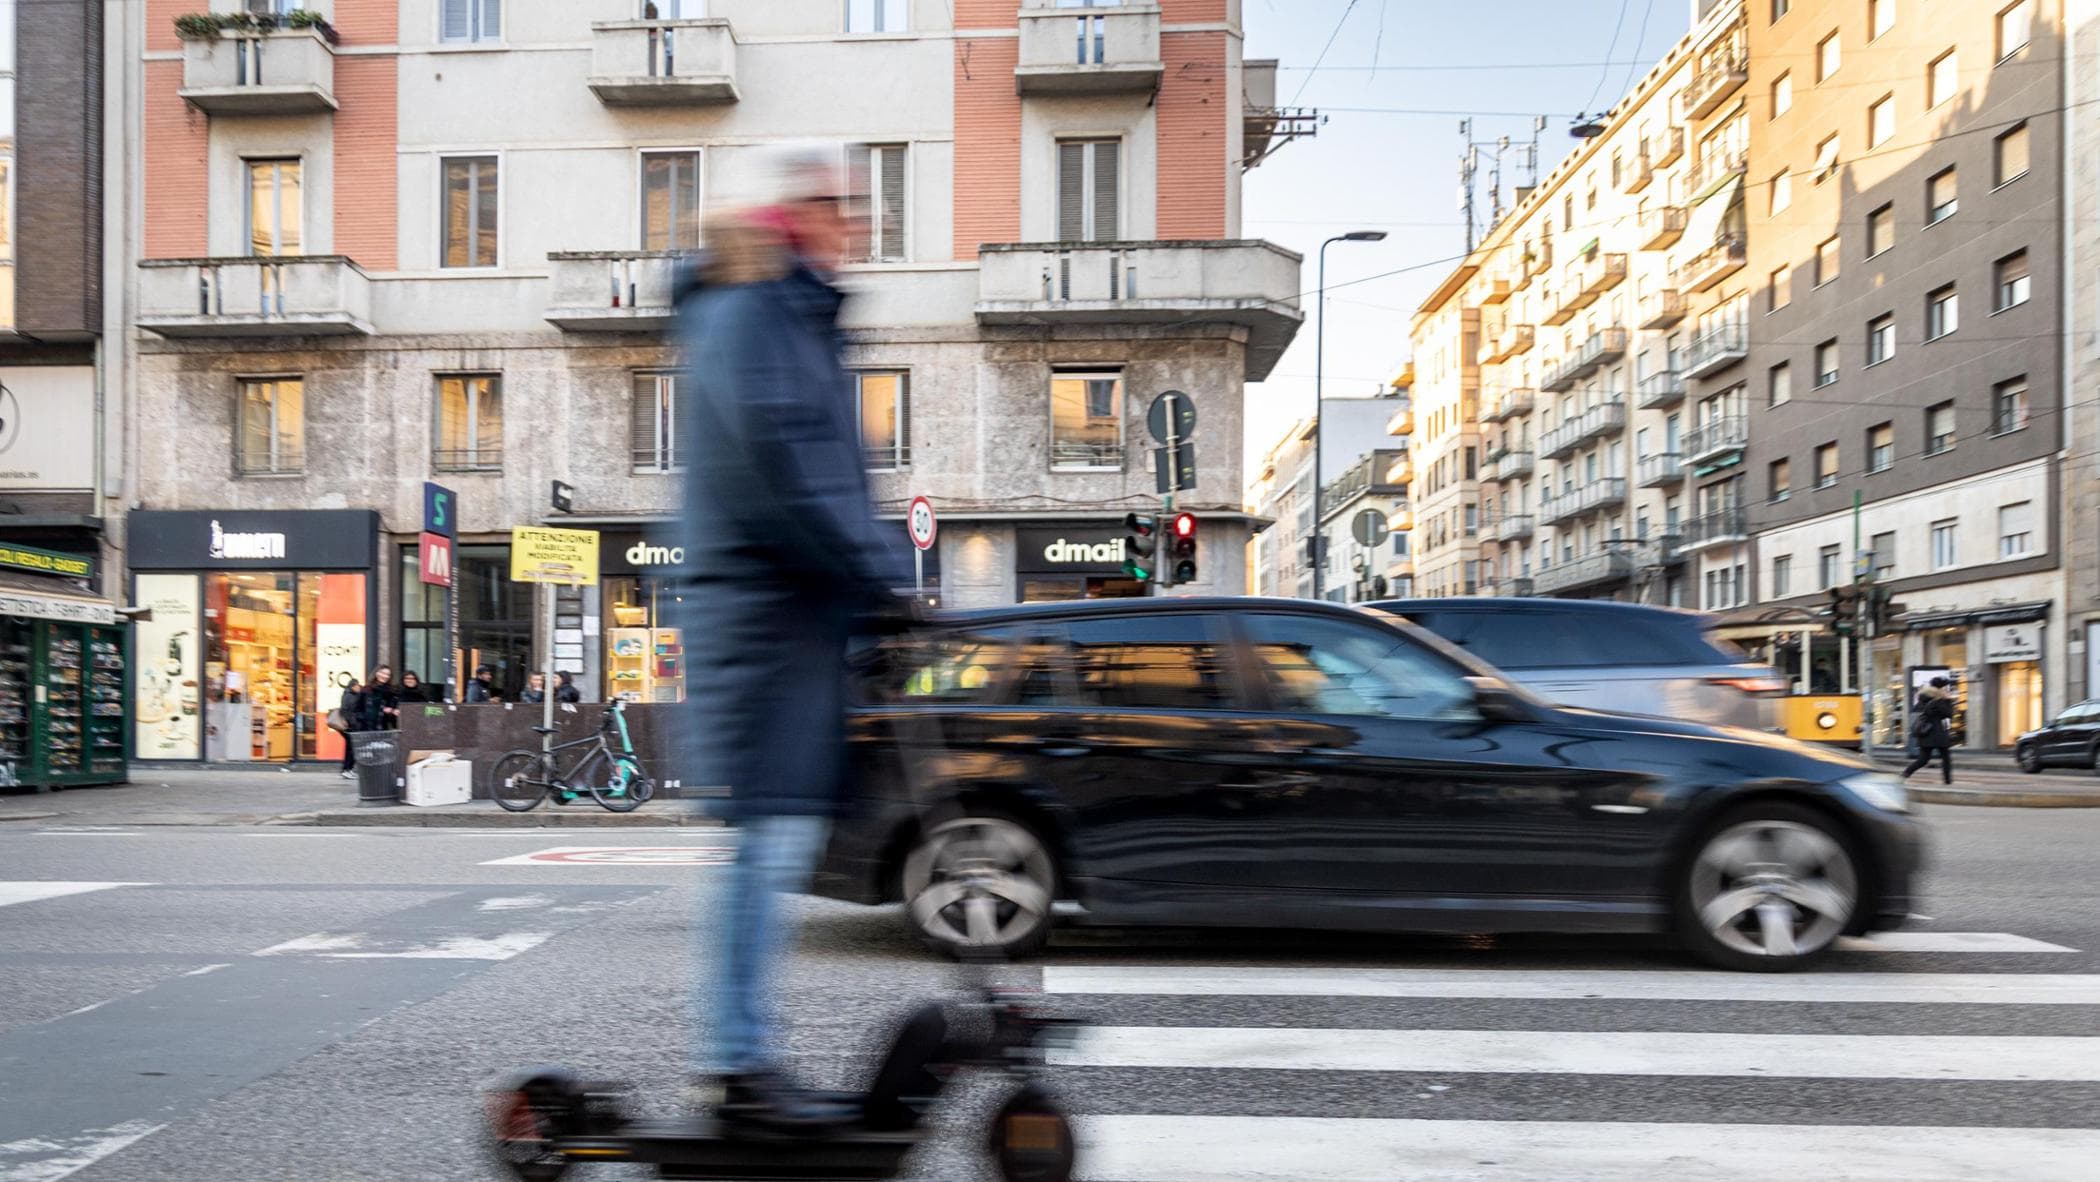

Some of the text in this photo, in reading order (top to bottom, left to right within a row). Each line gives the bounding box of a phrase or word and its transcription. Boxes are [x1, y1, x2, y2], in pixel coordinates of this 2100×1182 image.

[433, 493, 448, 526] S
[519, 531, 593, 544] ATTENZIONE
[428, 544, 449, 577] M
[527, 552, 583, 561] MODIFICATA
[626, 541, 685, 565] dma
[1044, 538, 1126, 562] dmail
